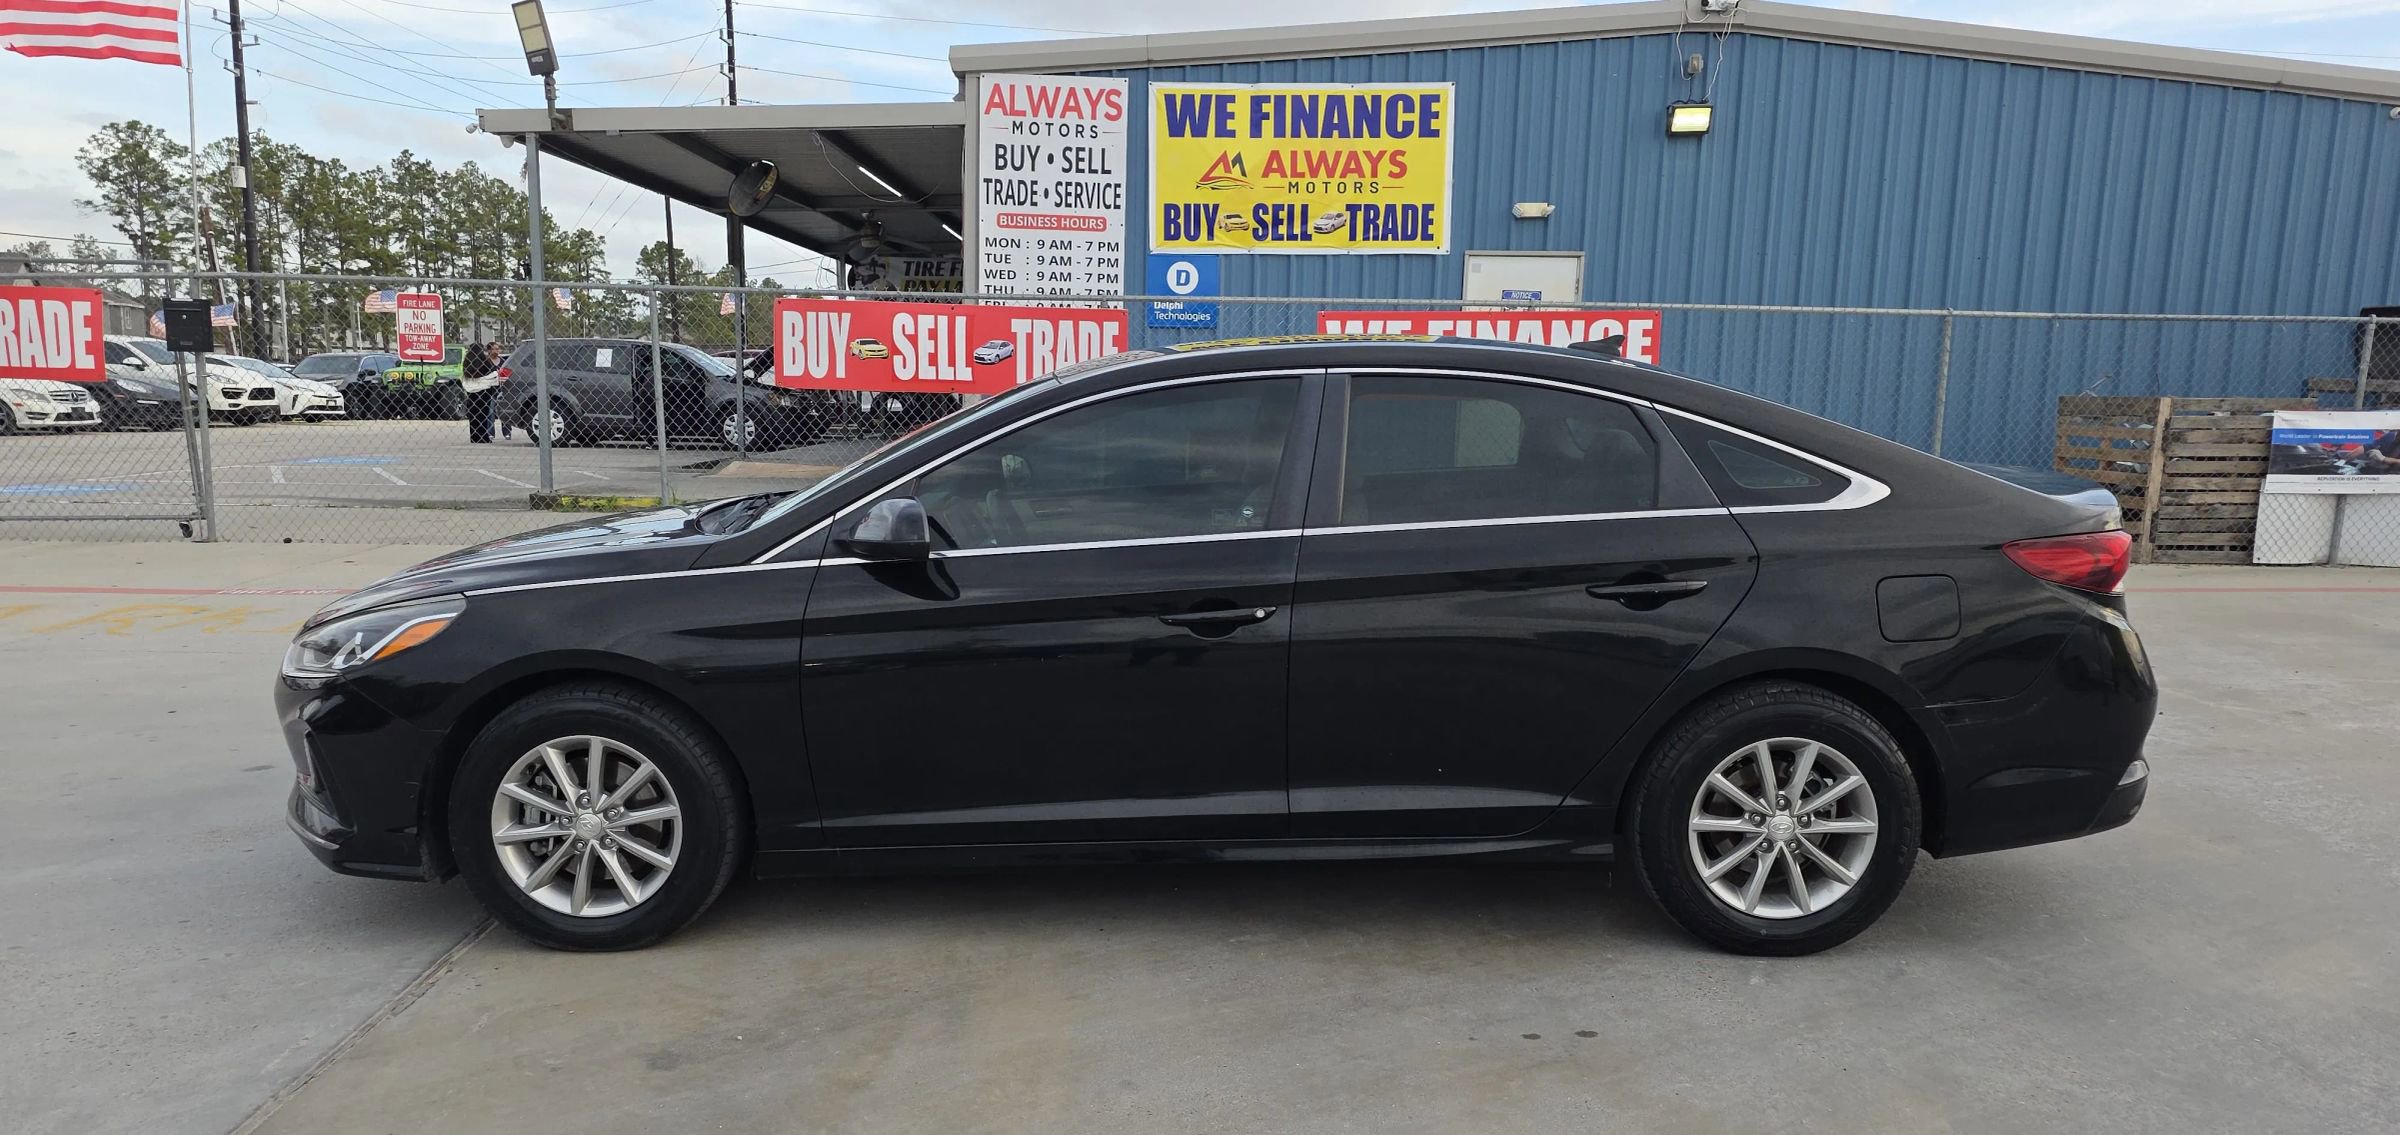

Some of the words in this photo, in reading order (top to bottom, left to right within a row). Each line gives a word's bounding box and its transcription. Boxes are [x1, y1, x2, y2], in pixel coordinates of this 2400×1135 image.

[984, 83, 1123, 121] ALWAYS
[1164, 93, 1237, 139] WE
[1250, 93, 1441, 139] FINANCE
[1012, 120, 1098, 139] MOTORS
[995, 143, 1041, 172] BUY
[1061, 146, 1112, 174] SELL
[1261, 150, 1408, 179] ALWAYS
[983, 178, 1039, 207] TRADE
[1054, 181, 1122, 210] SERVICE
[1287, 181, 1380, 194] MOTORS
[1000, 215, 1057, 228] BUSINESS
[1061, 217, 1104, 230] HOURS
[1163, 203, 1220, 242] BUY
[1252, 203, 1313, 242] SELL
[1346, 203, 1435, 242] TRADE
[985, 237, 1021, 248] MON
[1037, 240, 1045, 250] 9
[1049, 240, 1072, 250] AM
[1085, 241, 1093, 251] 7
[1098, 242, 1119, 252] PM
[985, 253, 1012, 264] TUE
[1037, 256, 1045, 265] 9
[1049, 256, 1072, 267] AM
[1085, 257, 1093, 267] 7
[1098, 257, 1119, 268] PM
[904, 261, 946, 276] TIRE
[950, 261, 963, 276] F
[984, 269, 1016, 280] WED
[1037, 271, 1045, 281] 9
[1049, 272, 1072, 282] AM
[1085, 273, 1093, 283] 7
[1098, 273, 1119, 284] PM
[1176, 270, 1191, 286] D
[984, 284, 1014, 295] THU
[1037, 287, 1045, 295] 9
[1049, 287, 1071, 295] AM
[403, 300, 417, 308] FIRE
[419, 300, 435, 308] LANE
[1154, 302, 1183, 311] Delphi
[413, 310, 426, 320] NO
[1154, 311, 1211, 322] Technologies
[404, 322, 436, 334] PARKING
[412, 342, 429, 350] ZONE
[782, 311, 851, 379] BUY
[892, 312, 974, 382] SELL
